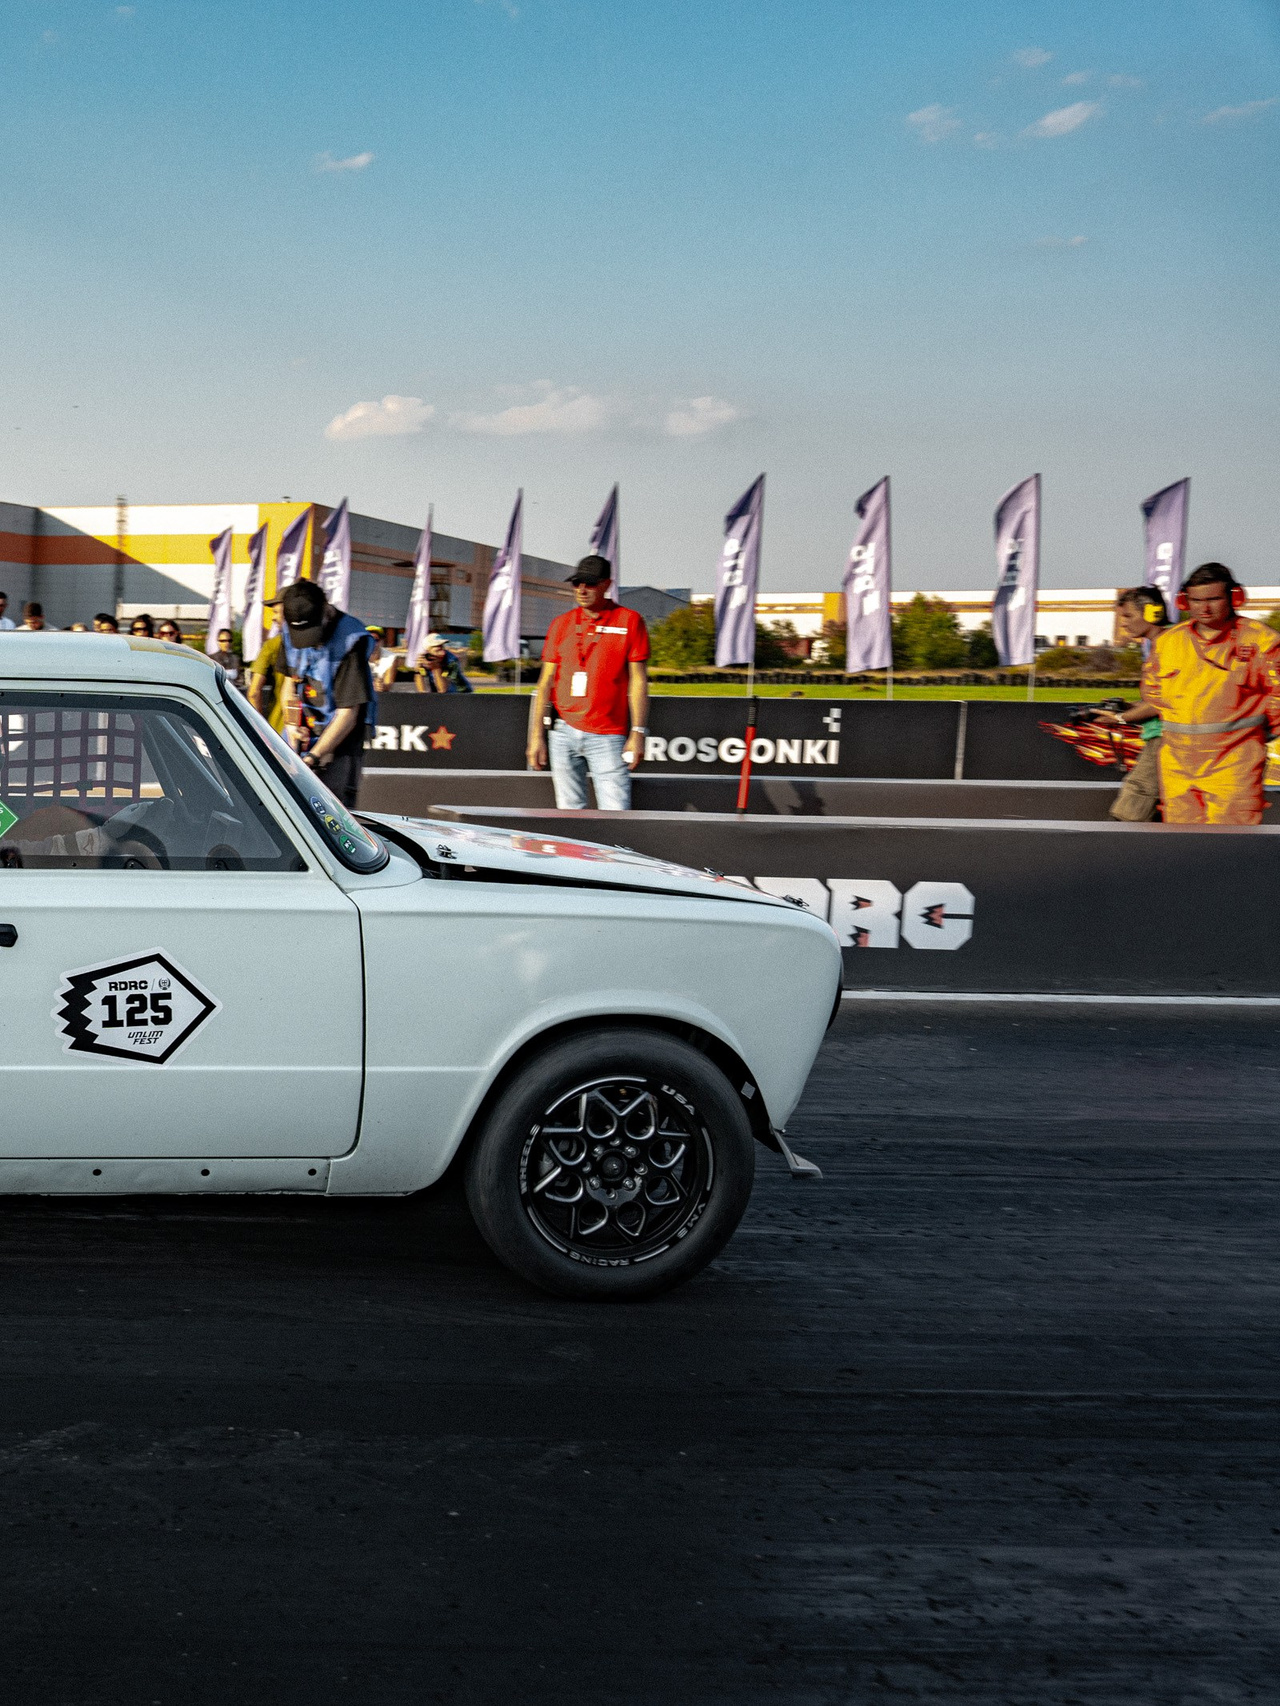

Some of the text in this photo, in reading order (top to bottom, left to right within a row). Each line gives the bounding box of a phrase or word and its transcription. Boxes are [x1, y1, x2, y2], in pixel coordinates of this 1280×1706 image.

[643, 736, 840, 765] ROSGONKI
[108, 980, 149, 991] RDRC
[101, 992, 173, 1028] 125
[127, 1030, 163, 1039] UNLIM
[132, 1037, 159, 1045] FEST
[661, 1084, 695, 1116] USA
[677, 1203, 706, 1239] VMS
[569, 1251, 630, 1267] RACING
